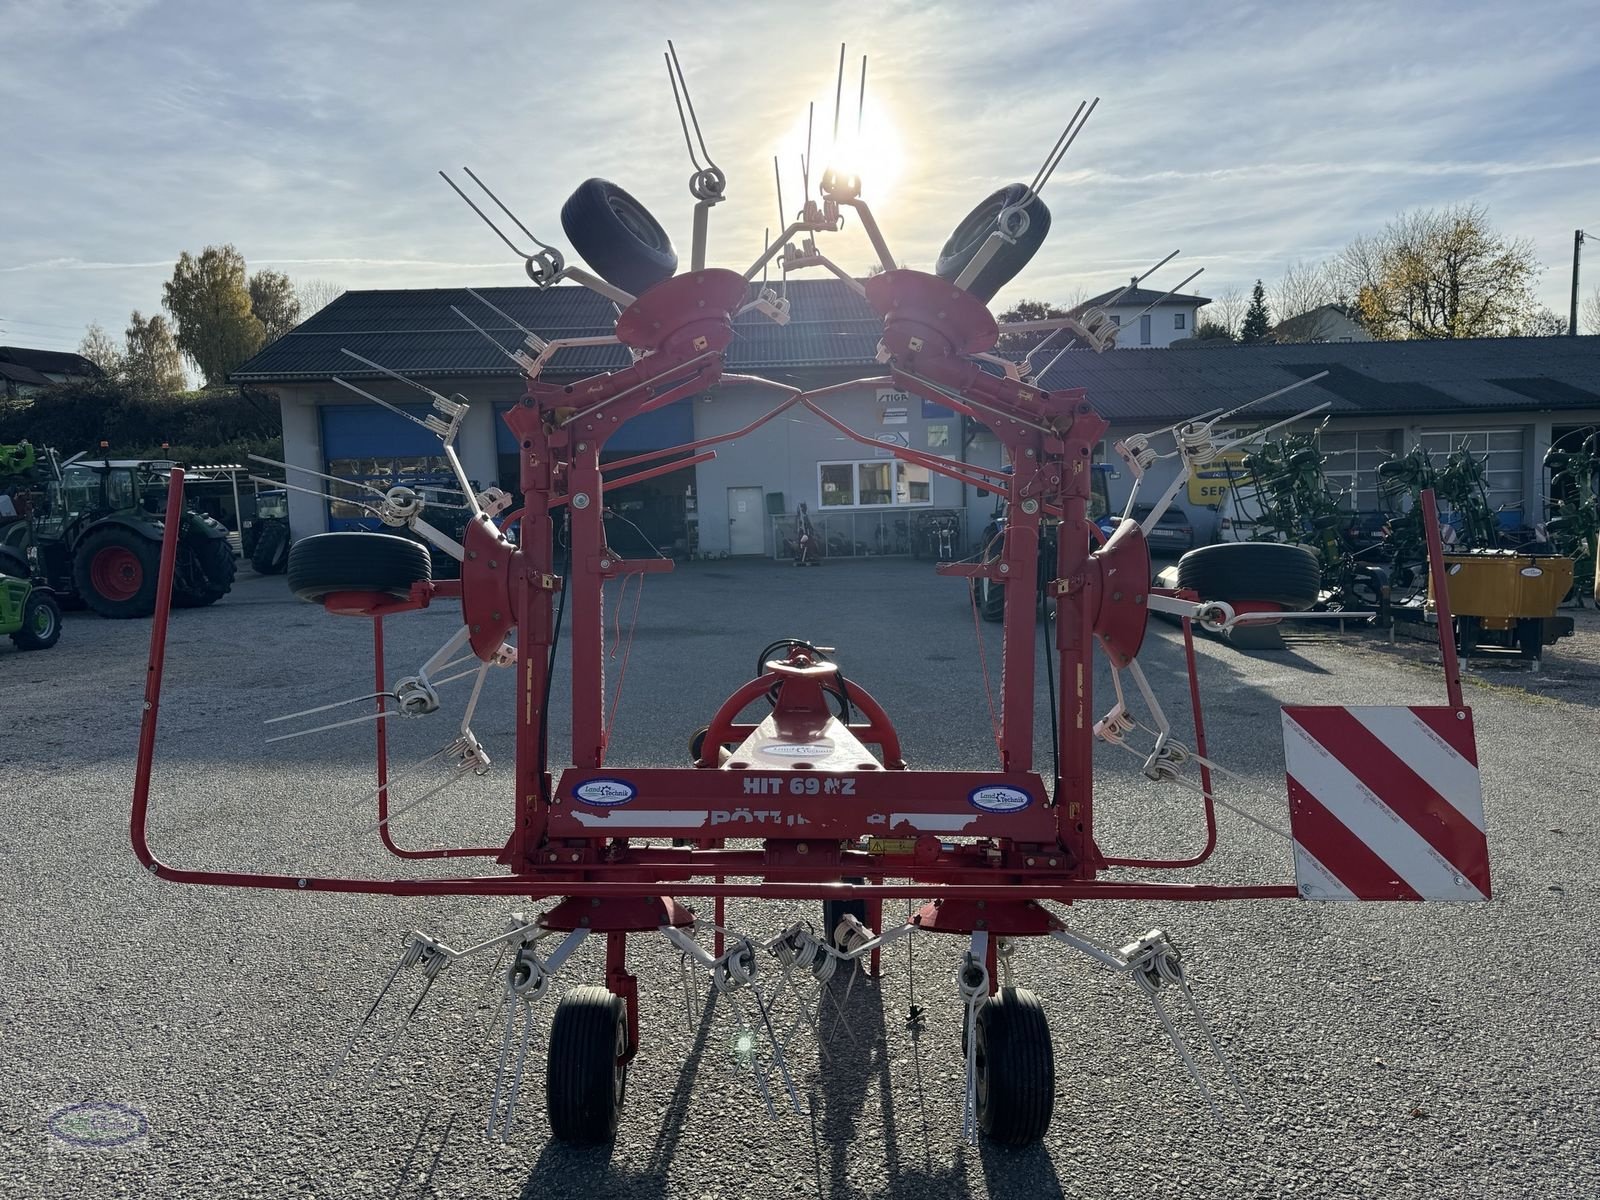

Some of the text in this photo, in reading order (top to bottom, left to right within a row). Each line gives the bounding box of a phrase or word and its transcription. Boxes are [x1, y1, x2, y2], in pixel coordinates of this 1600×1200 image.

[879, 393, 908, 402] STIGA
[1201, 486, 1226, 496] SER
[743, 777, 783, 794] HIT
[790, 777, 820, 795] 69
